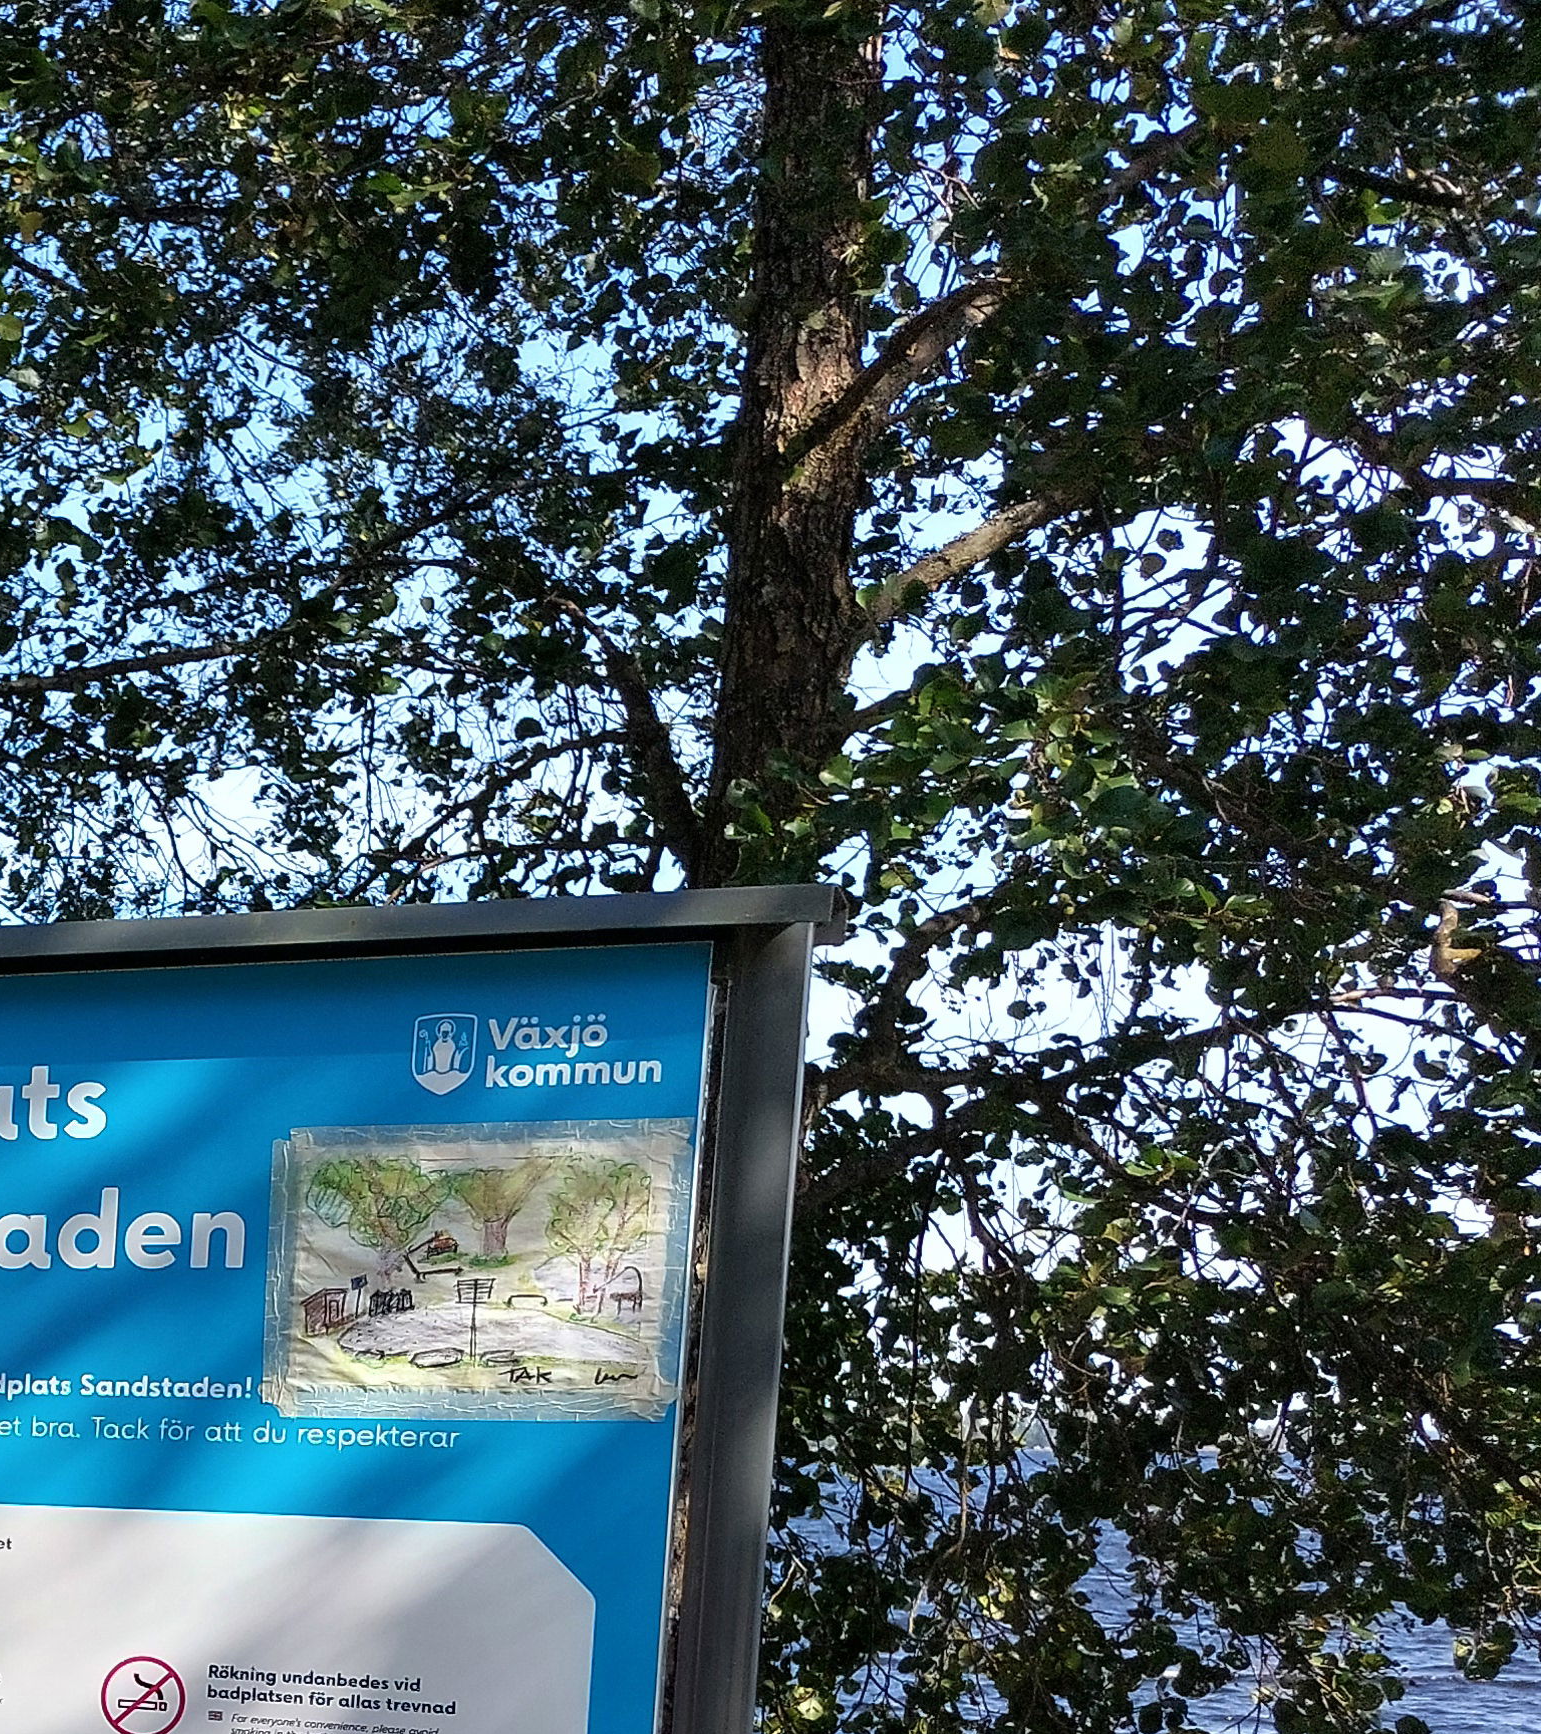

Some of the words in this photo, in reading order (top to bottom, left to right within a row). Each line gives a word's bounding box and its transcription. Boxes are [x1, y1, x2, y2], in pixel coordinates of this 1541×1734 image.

[488, 1013, 607, 1052] Växjö
[485, 1055, 661, 1087] kommun
[79, 1373, 253, 1398] Sandstaden!
[31, 1415, 80, 1438] bra.
[90, 1416, 149, 1439] Tack
[159, 1417, 194, 1440] för
[204, 1421, 242, 1442] att
[252, 1419, 286, 1443] du
[297, 1423, 460, 1451] respekterar
[207, 1664, 276, 1686] Rökning
[281, 1669, 389, 1690] undanbedes
[393, 1676, 421, 1692] vid
[206, 1683, 303, 1704] badplatsen
[308, 1691, 334, 1706] för
[338, 1693, 381, 1710] allas
[385, 1697, 456, 1714] trevnad
